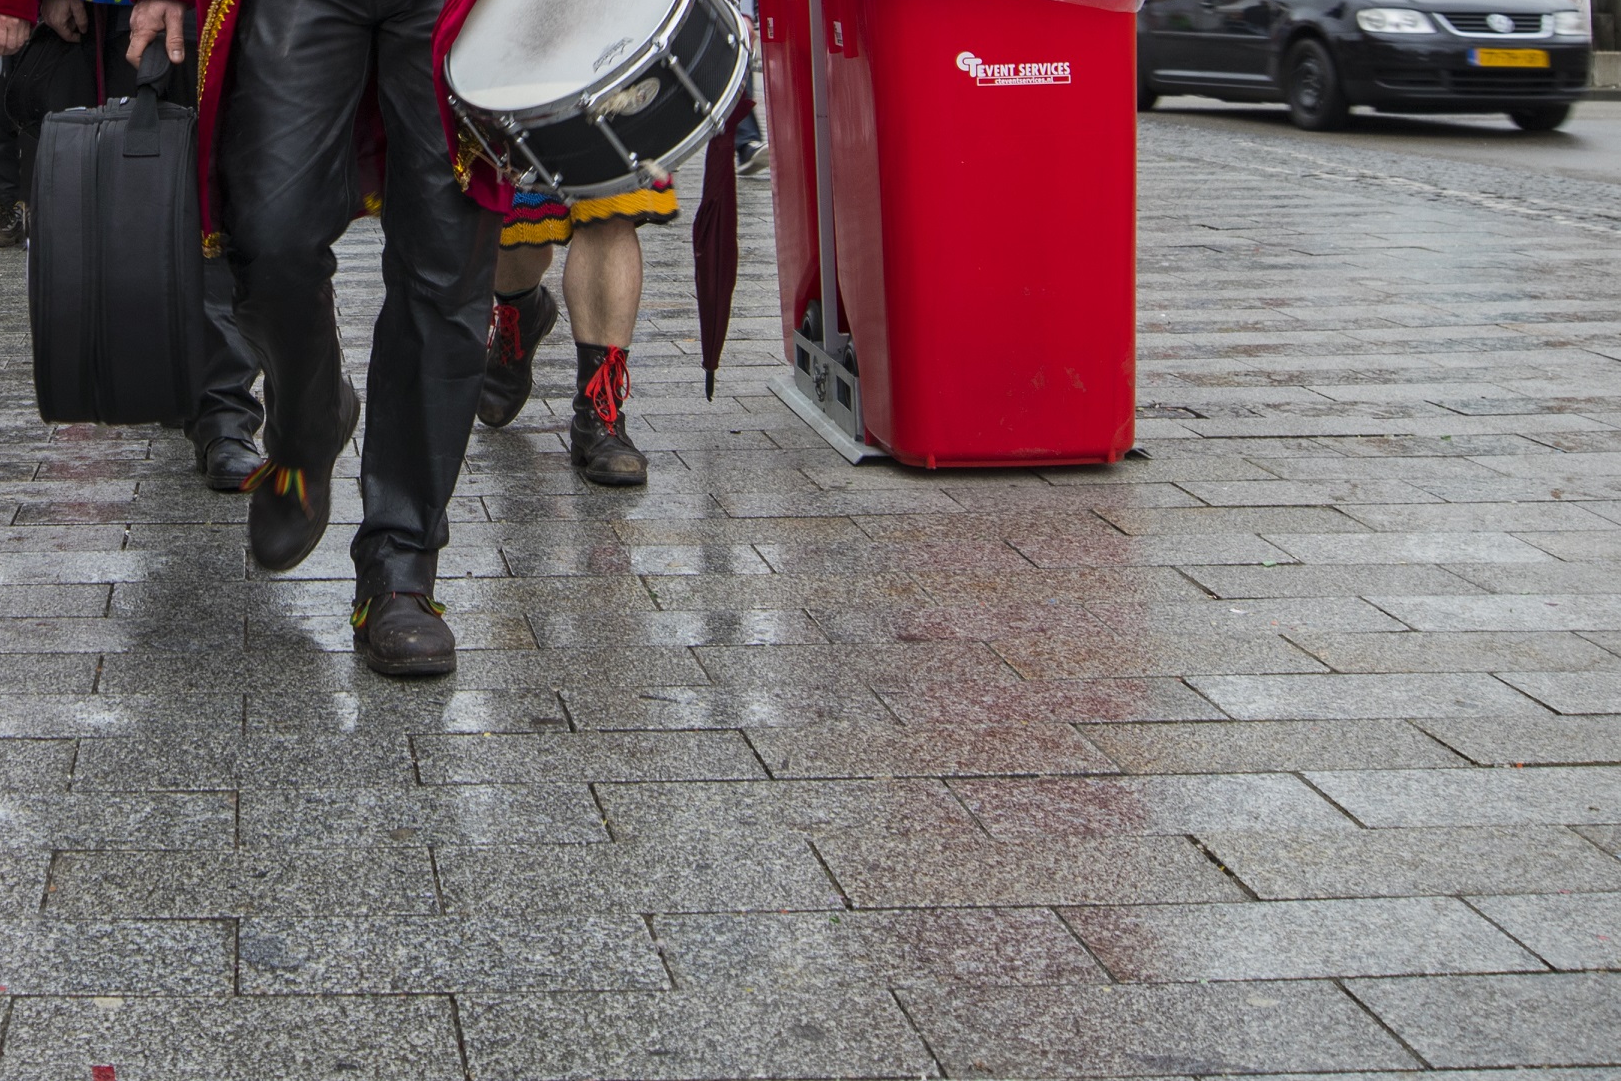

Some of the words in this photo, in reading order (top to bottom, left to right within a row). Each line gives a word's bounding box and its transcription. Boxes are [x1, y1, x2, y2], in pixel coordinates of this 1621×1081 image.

[977, 63, 1016, 78] EVENT
[1018, 61, 1071, 76] SERVICES
[994, 76, 1054, 85] cteventservices.nl
